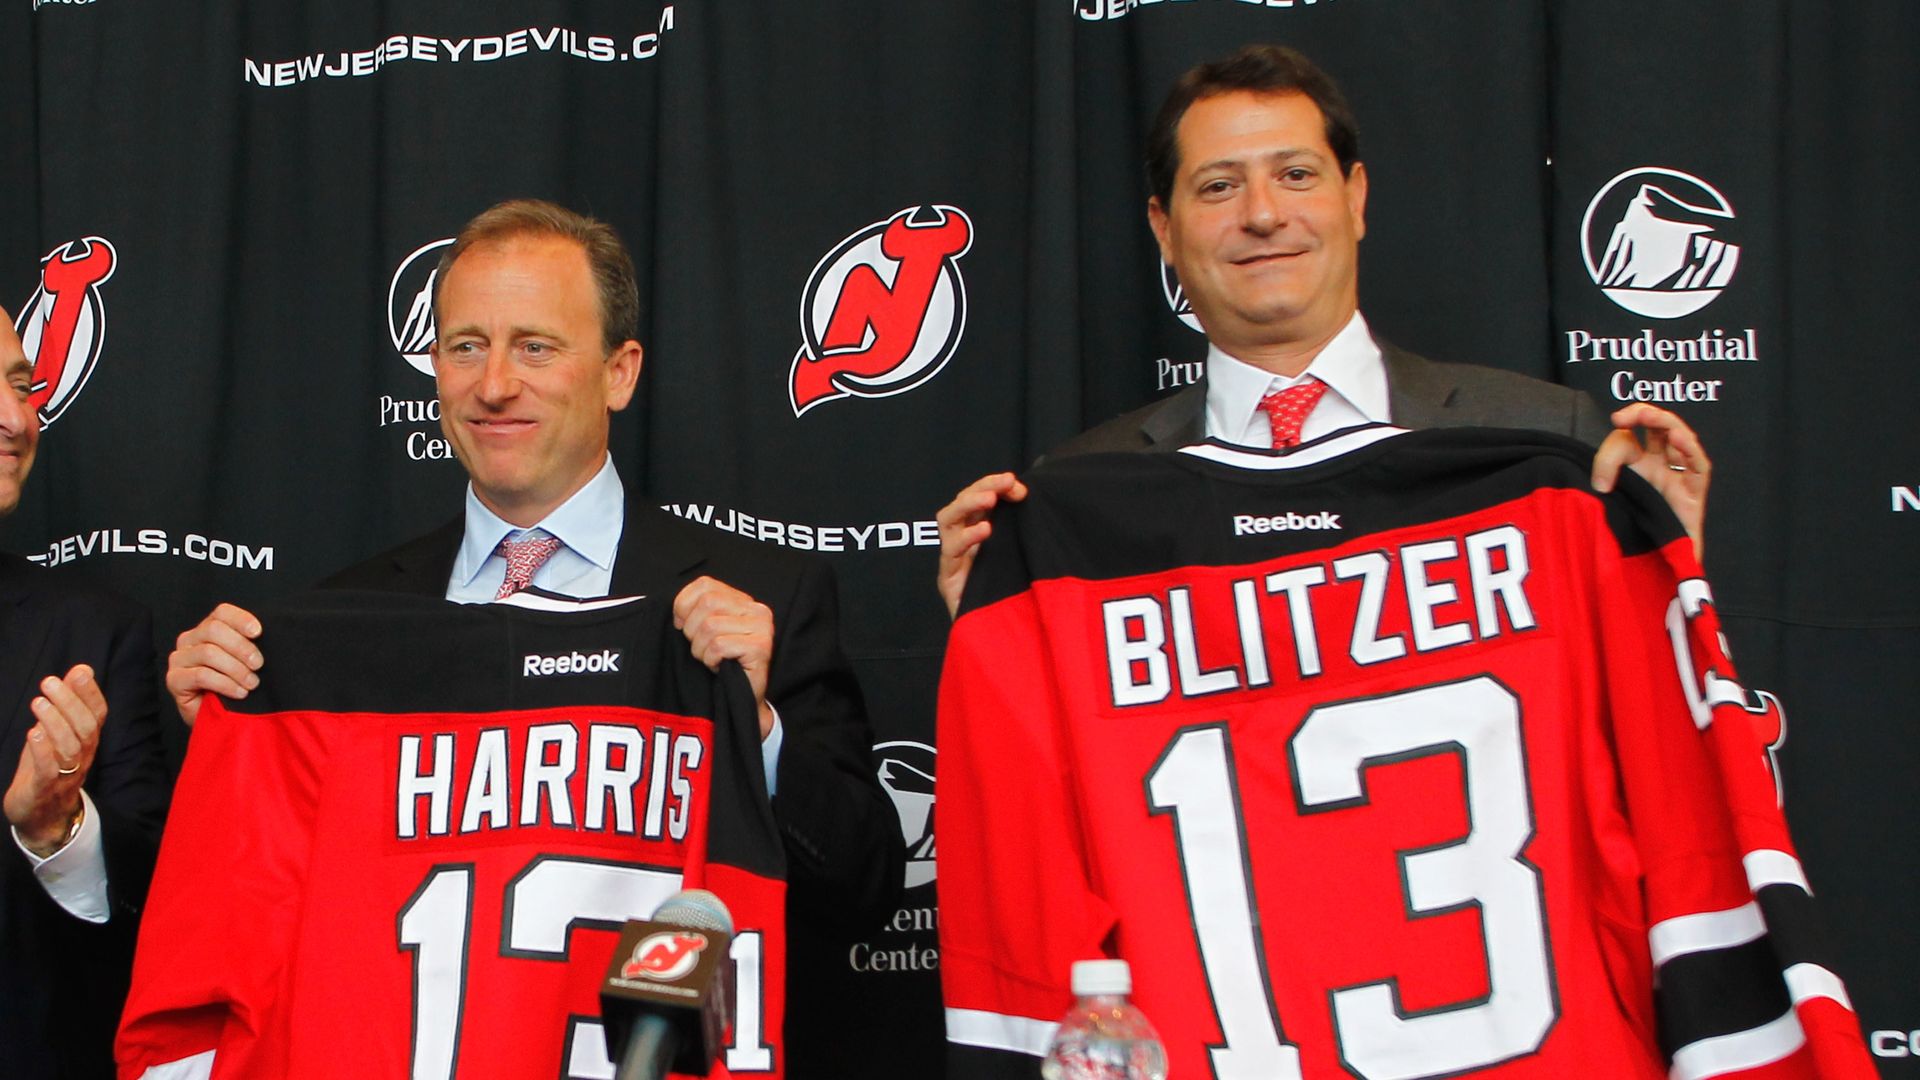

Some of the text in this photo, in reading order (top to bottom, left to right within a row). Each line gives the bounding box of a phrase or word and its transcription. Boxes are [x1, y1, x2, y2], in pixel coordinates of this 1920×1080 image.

[245, 6, 674, 87] NEWJERSEYDEVILS.CM
[1566, 329, 1758, 362] Prudential
[1156, 358, 1204, 390] Pru
[1611, 371, 1722, 401] Center
[1891, 485, 1920, 512] N
[660, 503, 941, 552] WJERSEYDE
[1233, 511, 1341, 537] Reebok
[26, 528, 274, 571] DEVILS.COM
[1103, 524, 1537, 708] BLITZER
[522, 649, 620, 677] Reebok
[397, 721, 704, 842] HARRIS
[1144, 674, 1562, 1080] 13
[849, 942, 939, 972] Cente
